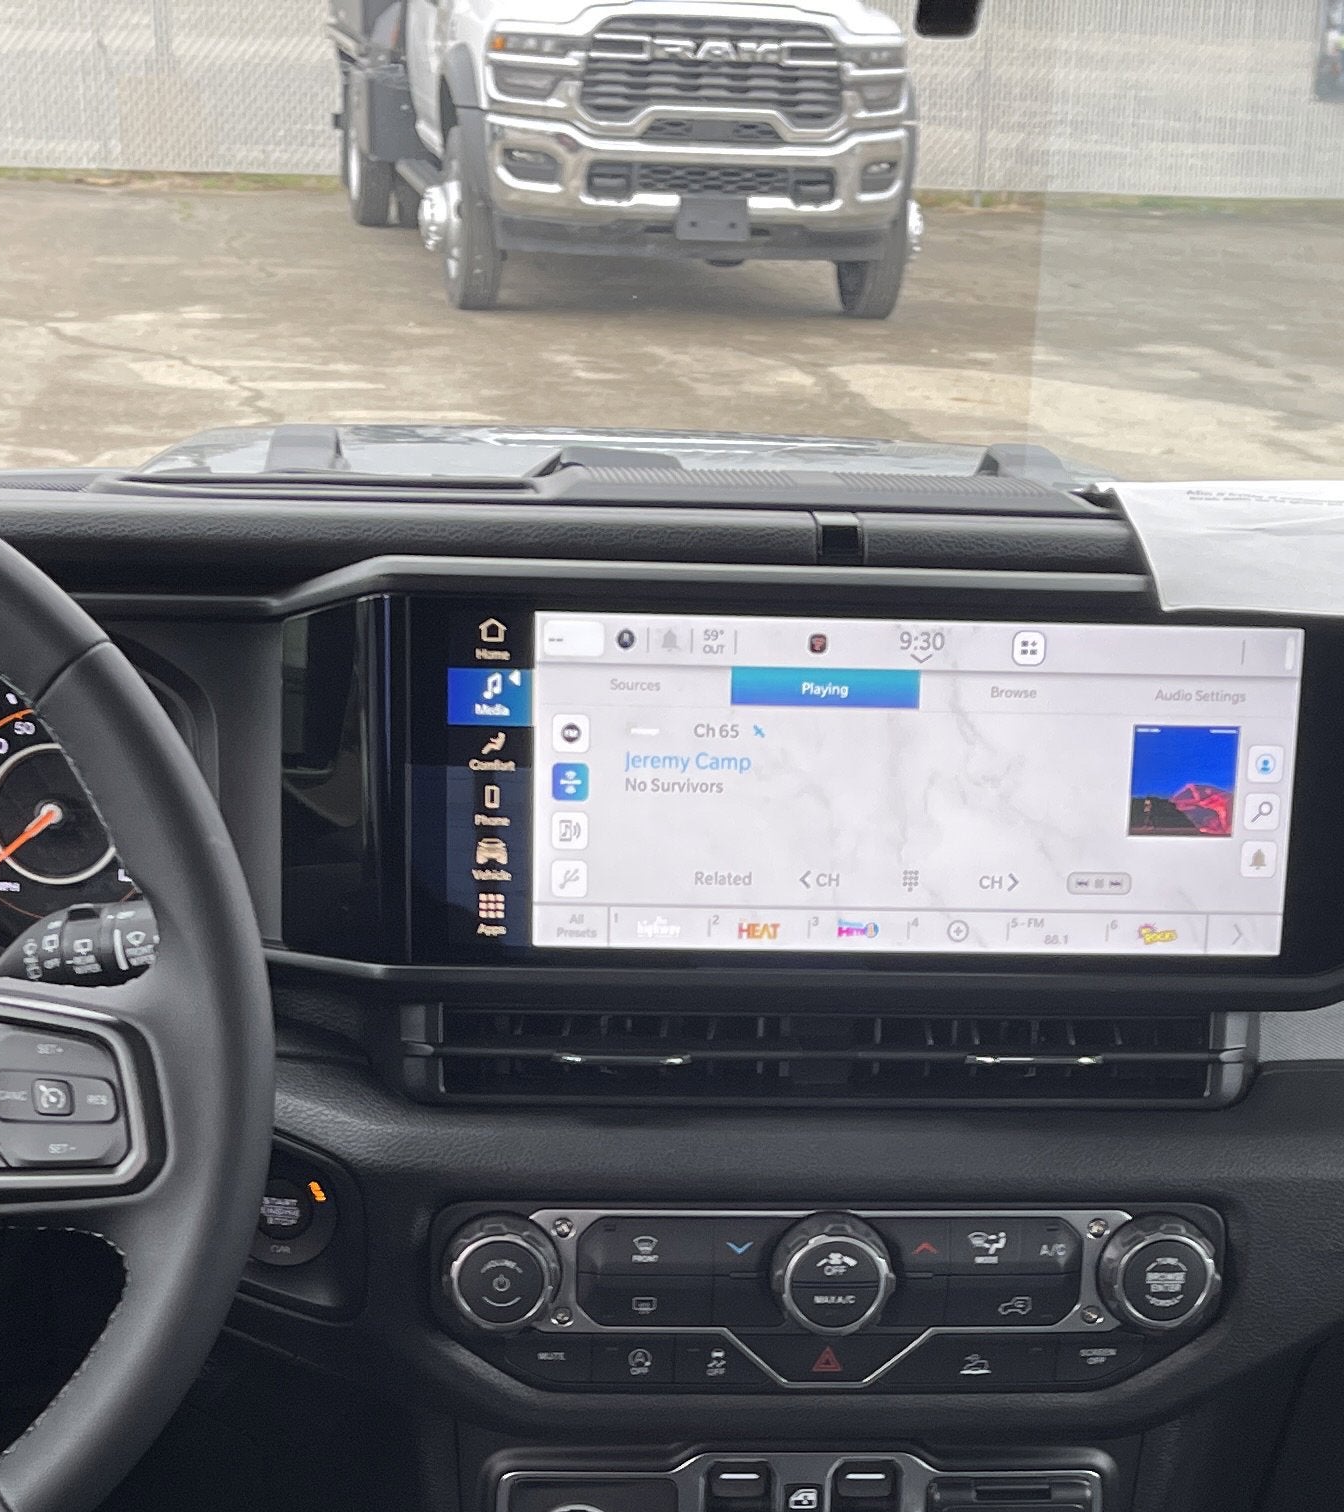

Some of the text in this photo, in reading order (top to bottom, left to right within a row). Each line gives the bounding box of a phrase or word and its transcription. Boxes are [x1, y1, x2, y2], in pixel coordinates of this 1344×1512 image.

[653, 37, 779, 62] RAM
[702, 644, 725, 655] OUT
[899, 631, 946, 653] 9:30
[609, 678, 1247, 706] Sources Playing Browse Audio Settings
[693, 723, 740, 739] Ch 65
[624, 751, 752, 774] Jeremy Camp
[624, 777, 725, 794] No Survivors
[694, 871, 841, 888] Related CH
[978, 875, 1003, 891] CH
[556, 926, 598, 940] Presets
[737, 922, 781, 940] HEAT
[1040, 1243, 1067, 1257] A/C
[824, 1265, 848, 1277] OFF
[813, 1295, 837, 1305] MAX
[629, 1366, 650, 1376] OFF
[706, 1367, 727, 1377] OFF
